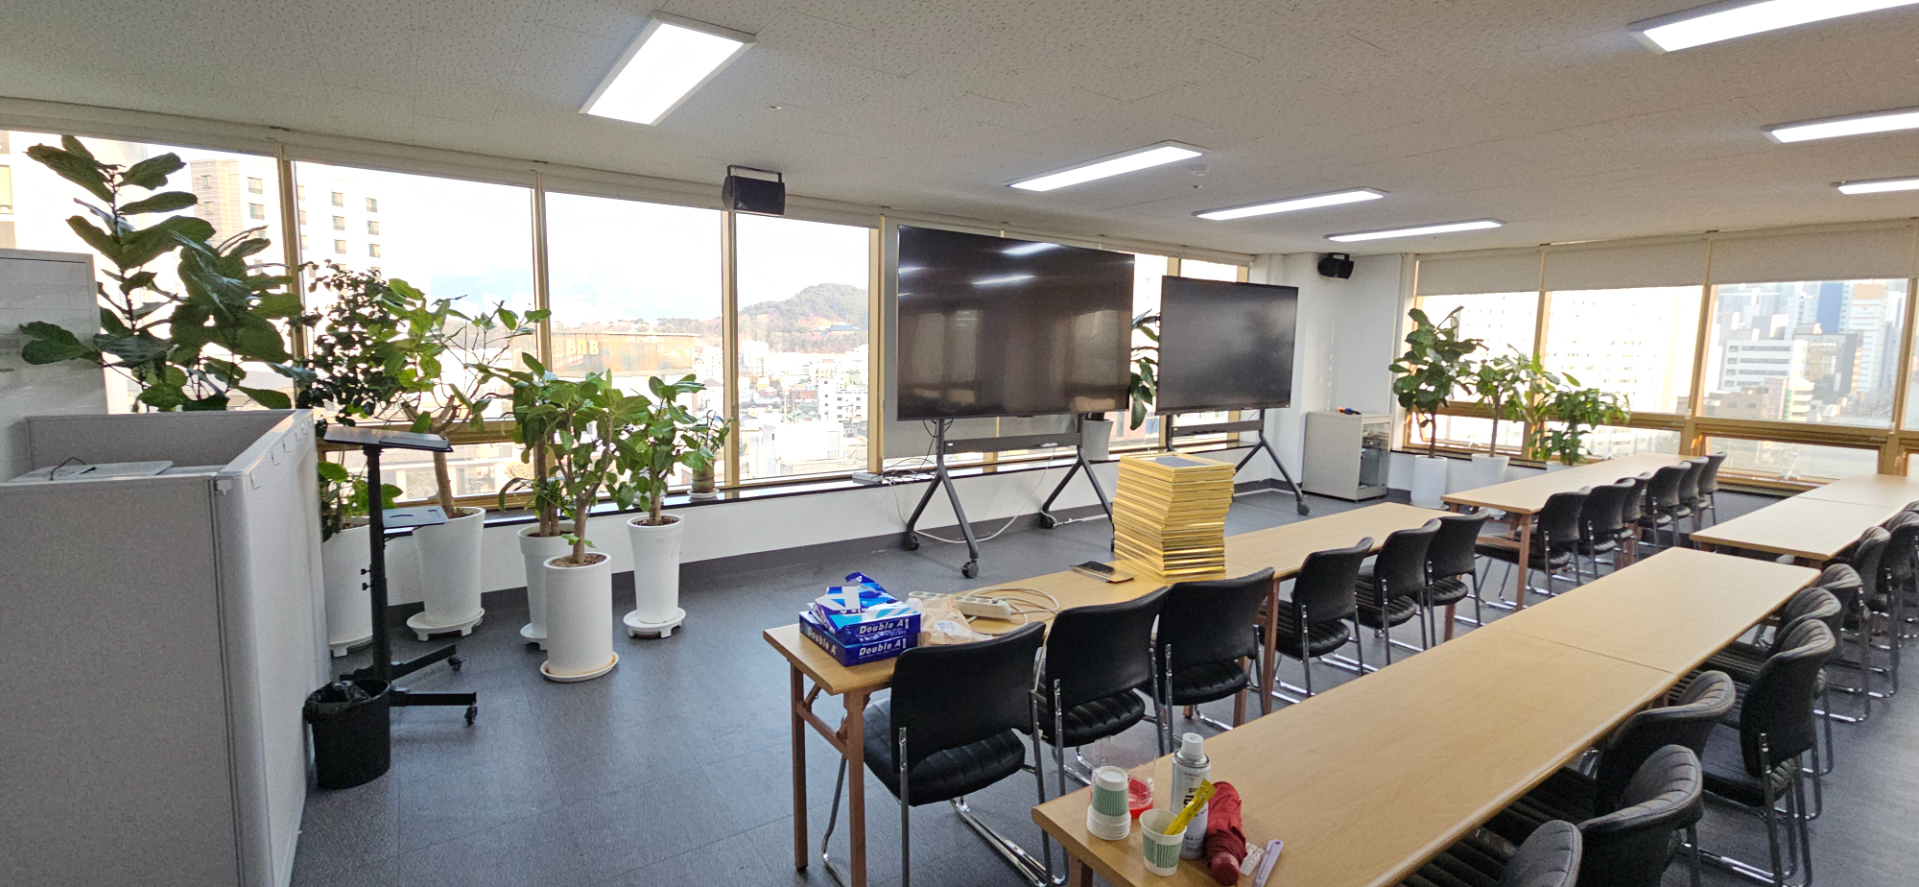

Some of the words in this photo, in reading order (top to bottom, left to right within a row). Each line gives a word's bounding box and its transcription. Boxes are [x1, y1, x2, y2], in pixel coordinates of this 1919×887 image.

[859, 621, 894, 634] Double
[896, 619, 904, 627] A
[807, 626, 829, 650] Double
[830, 644, 837, 655] A
[859, 642, 892, 656] Double
[894, 639, 901, 647] A
